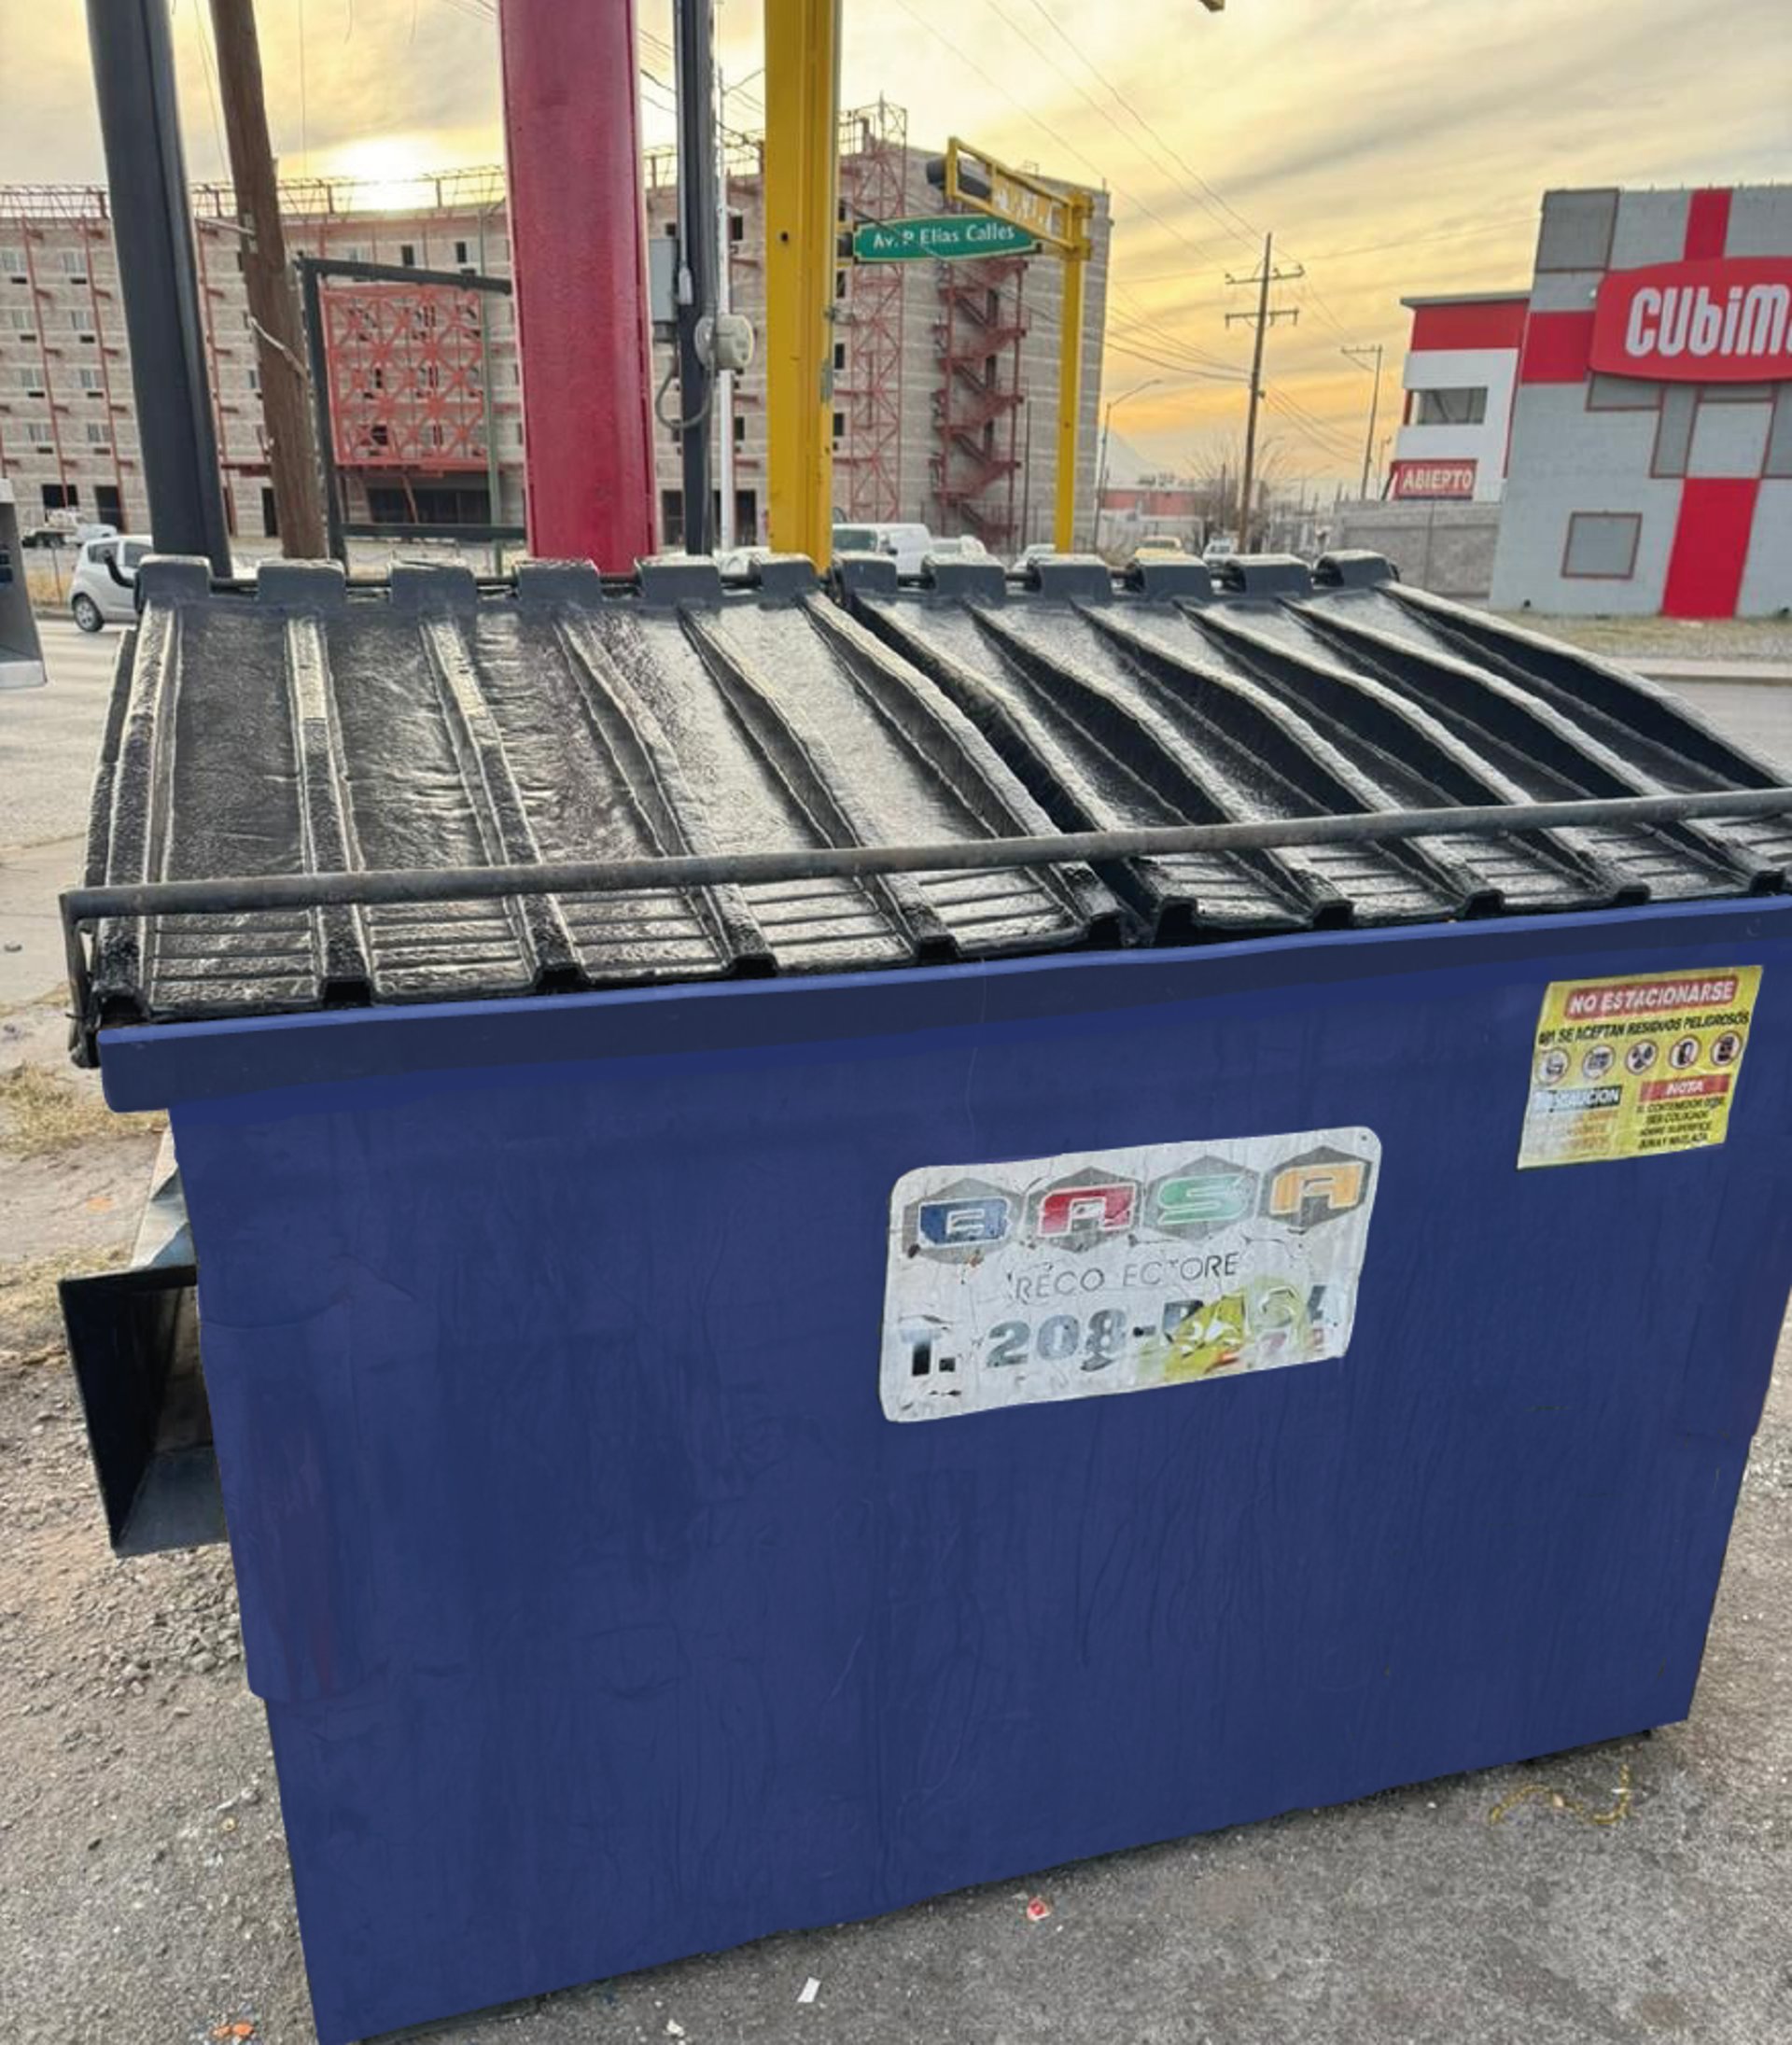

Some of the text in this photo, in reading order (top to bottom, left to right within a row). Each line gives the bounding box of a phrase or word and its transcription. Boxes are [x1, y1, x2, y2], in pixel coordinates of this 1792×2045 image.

[873, 233, 899, 249] Av.
[966, 221, 1015, 242] Calles
[1625, 284, 1792, 358] CUbiM
[1403, 469, 1473, 491] ABIERTO
[1569, 980, 1734, 1015] NO ESTACIONARSE
[1558, 1028, 1575, 1044] SE
[1575, 1024, 1625, 1041] ACEPTAN
[1627, 1017, 1682, 1036] RESIDUOS
[1683, 1011, 1750, 1030] PELIGROSOS
[1667, 1080, 1704, 1096] NOTA
